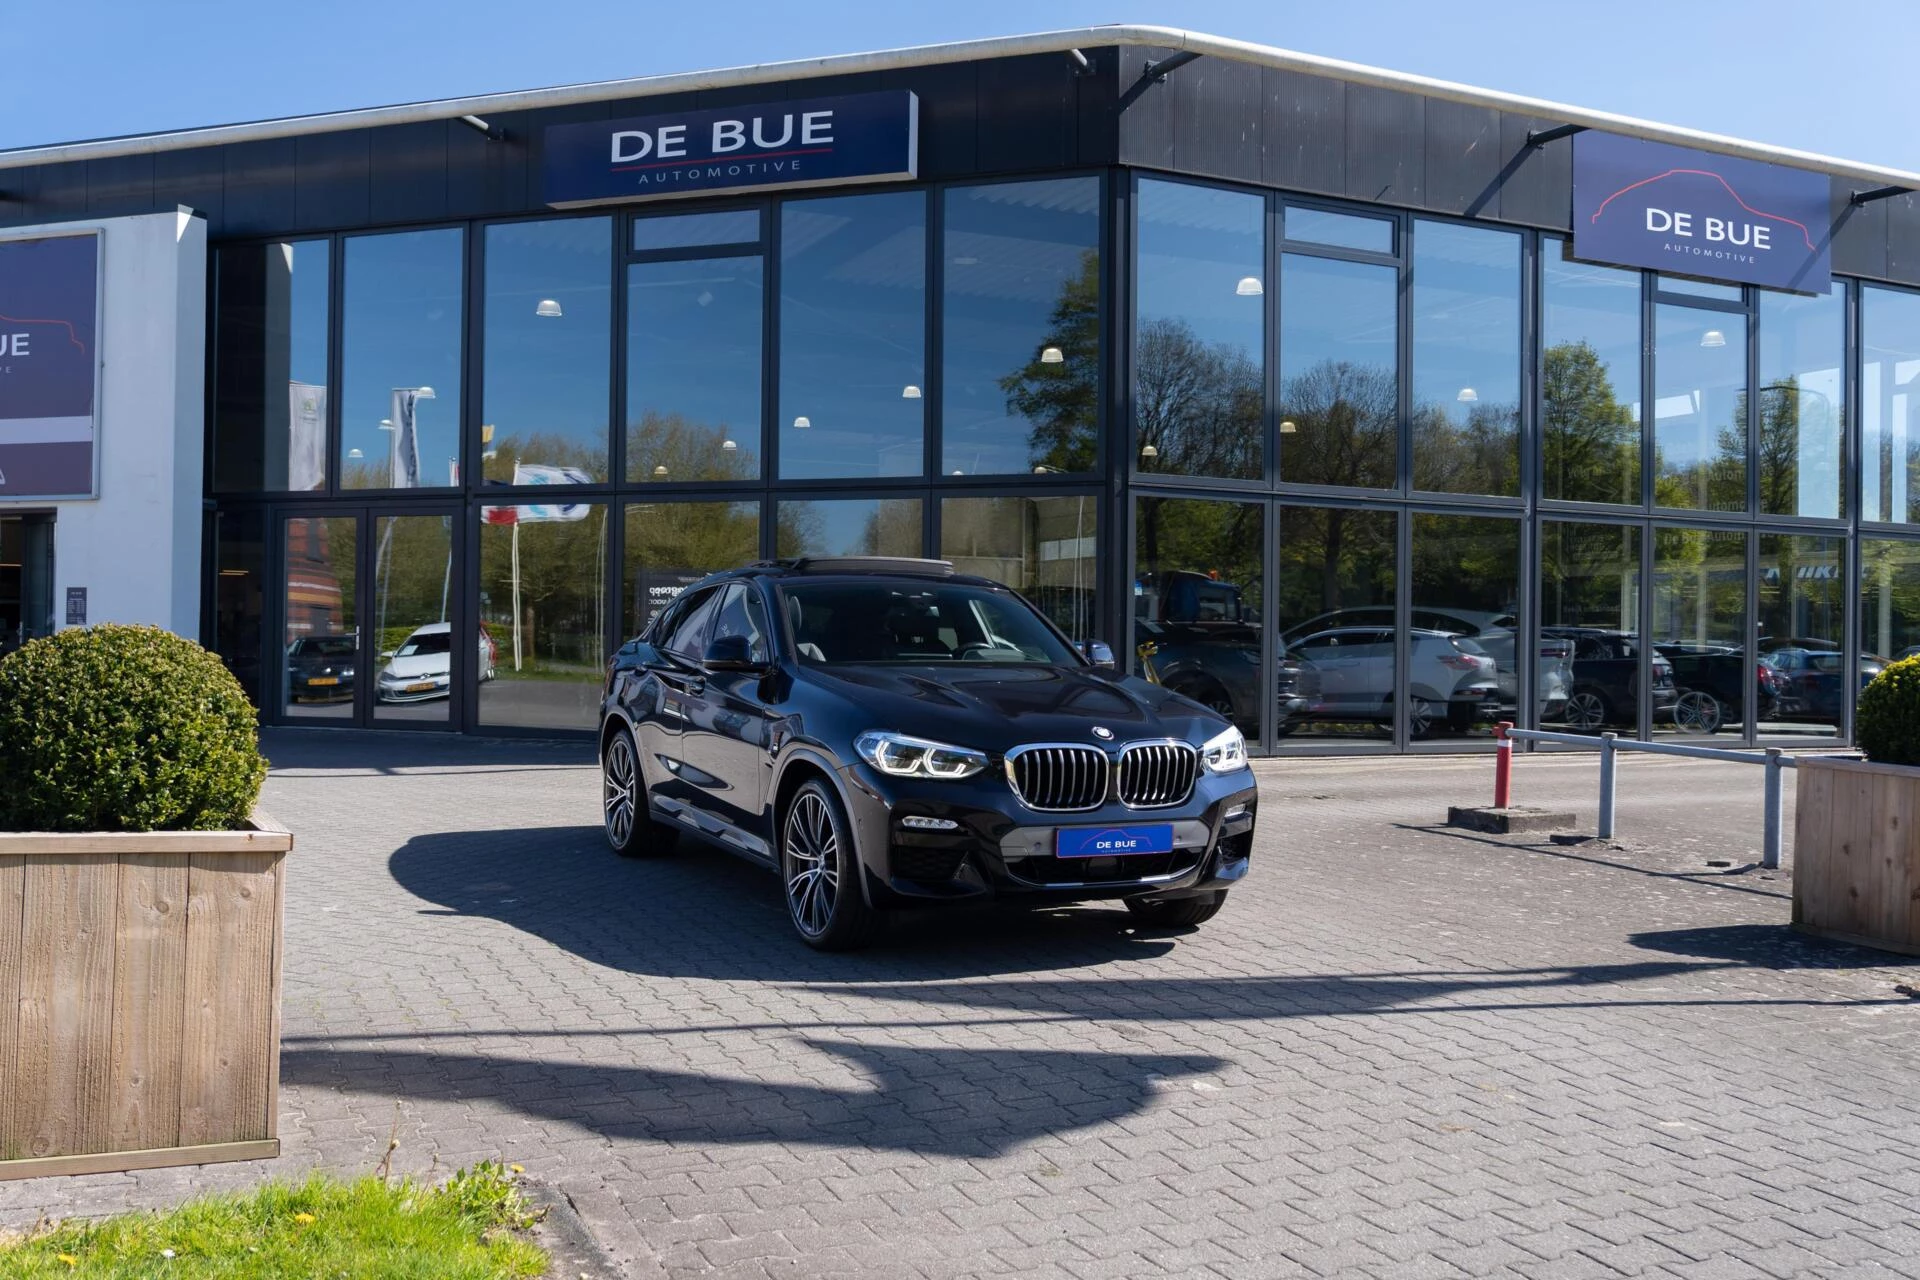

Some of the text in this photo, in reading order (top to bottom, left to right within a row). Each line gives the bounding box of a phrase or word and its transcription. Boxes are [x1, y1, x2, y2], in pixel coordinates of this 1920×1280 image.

[610, 110, 834, 163] DE BUE
[638, 160, 801, 184] AUTOMOTIVE
[1646, 207, 1771, 250] DE BUE
[1664, 243, 1755, 264] AUTOMOTIVE
[1115, 840, 1136, 848] BUE
